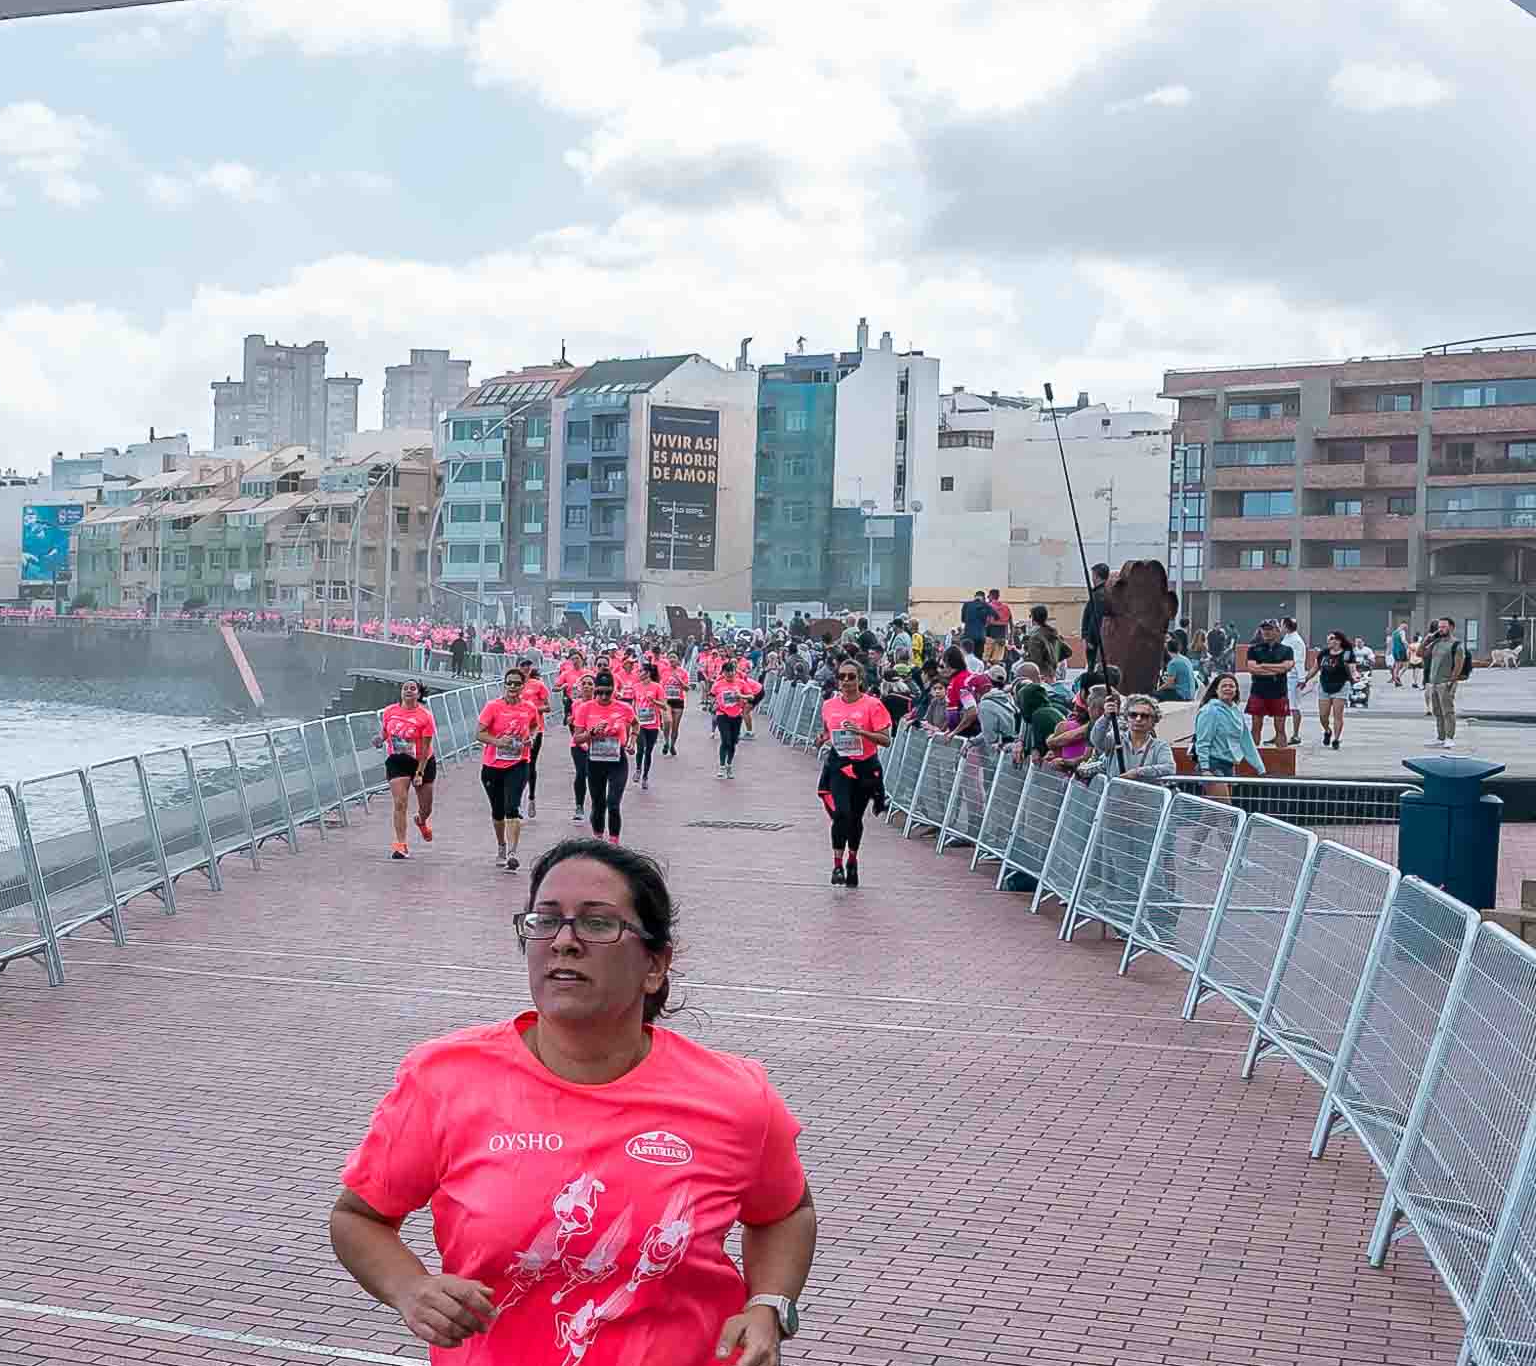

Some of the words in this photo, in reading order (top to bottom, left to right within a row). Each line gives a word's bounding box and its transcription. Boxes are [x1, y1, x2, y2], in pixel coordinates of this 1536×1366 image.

[652, 433, 692, 450] VIVIR
[653, 450, 668, 464] ES
[671, 452, 716, 468] MORIR
[652, 466, 670, 480] DE
[673, 468, 716, 484] AMOR
[488, 1133, 563, 1152] OYSHO
